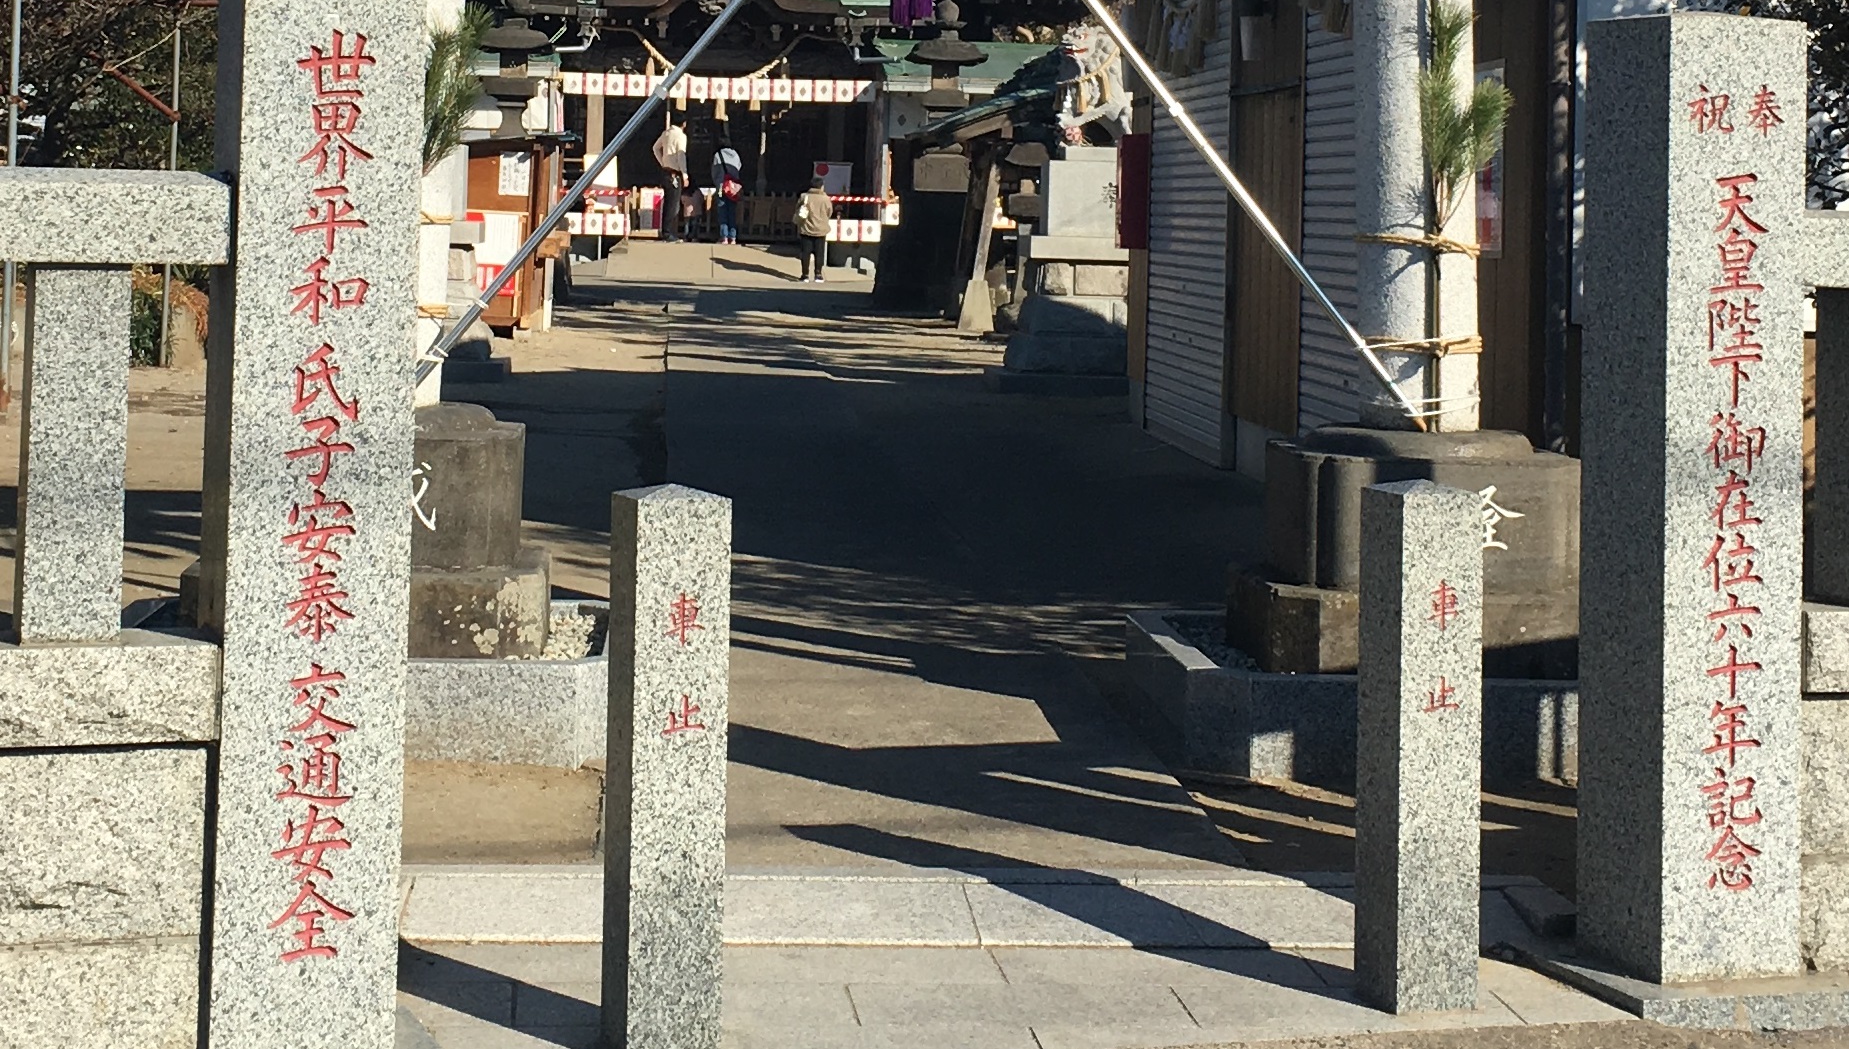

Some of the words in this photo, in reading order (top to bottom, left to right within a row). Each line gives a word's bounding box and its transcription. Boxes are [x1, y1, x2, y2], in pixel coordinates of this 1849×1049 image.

[289, 28, 377, 327] 世界平和
[281, 341, 359, 644] 氏子安泰
[1701, 172, 1769, 891] 天皇陛下御在位六十年記念
[661, 591, 706, 738] 車止
[1421, 578, 1460, 714] 車止
[268, 661, 358, 963] 交通安全
